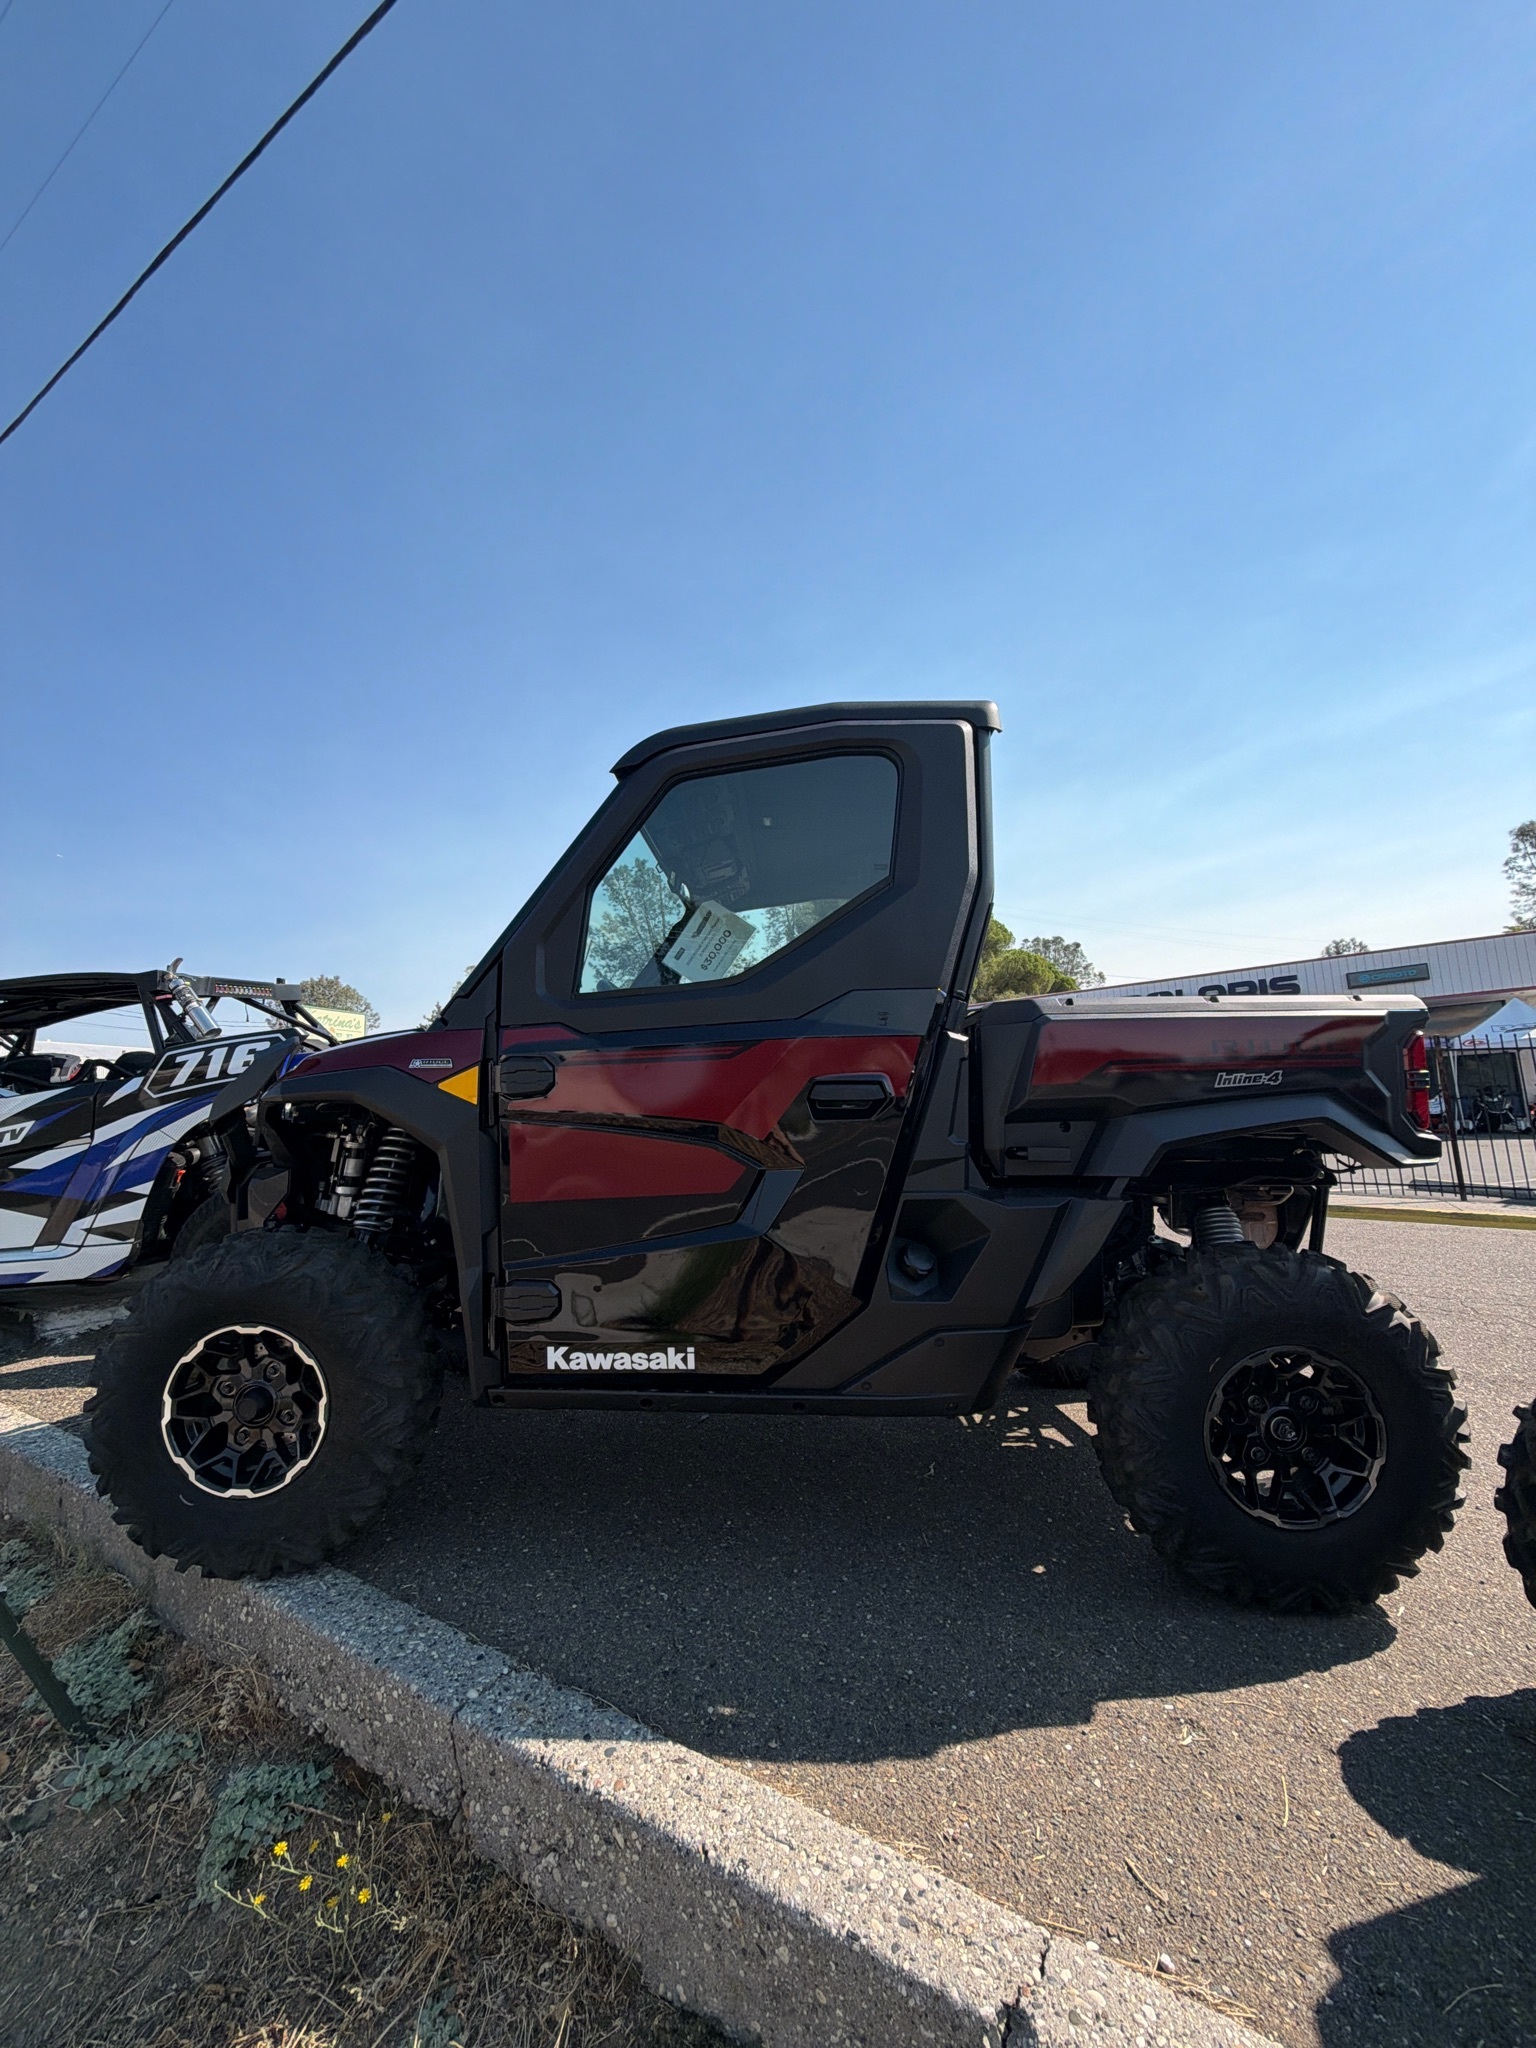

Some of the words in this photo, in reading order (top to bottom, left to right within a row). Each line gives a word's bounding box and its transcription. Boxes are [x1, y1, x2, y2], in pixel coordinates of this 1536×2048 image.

[701, 929, 732, 971] $30,000
[169, 1041, 271, 1088] 716
[1214, 1070, 1283, 1089] Inline-4
[546, 1346, 695, 1371] Kawasaki
